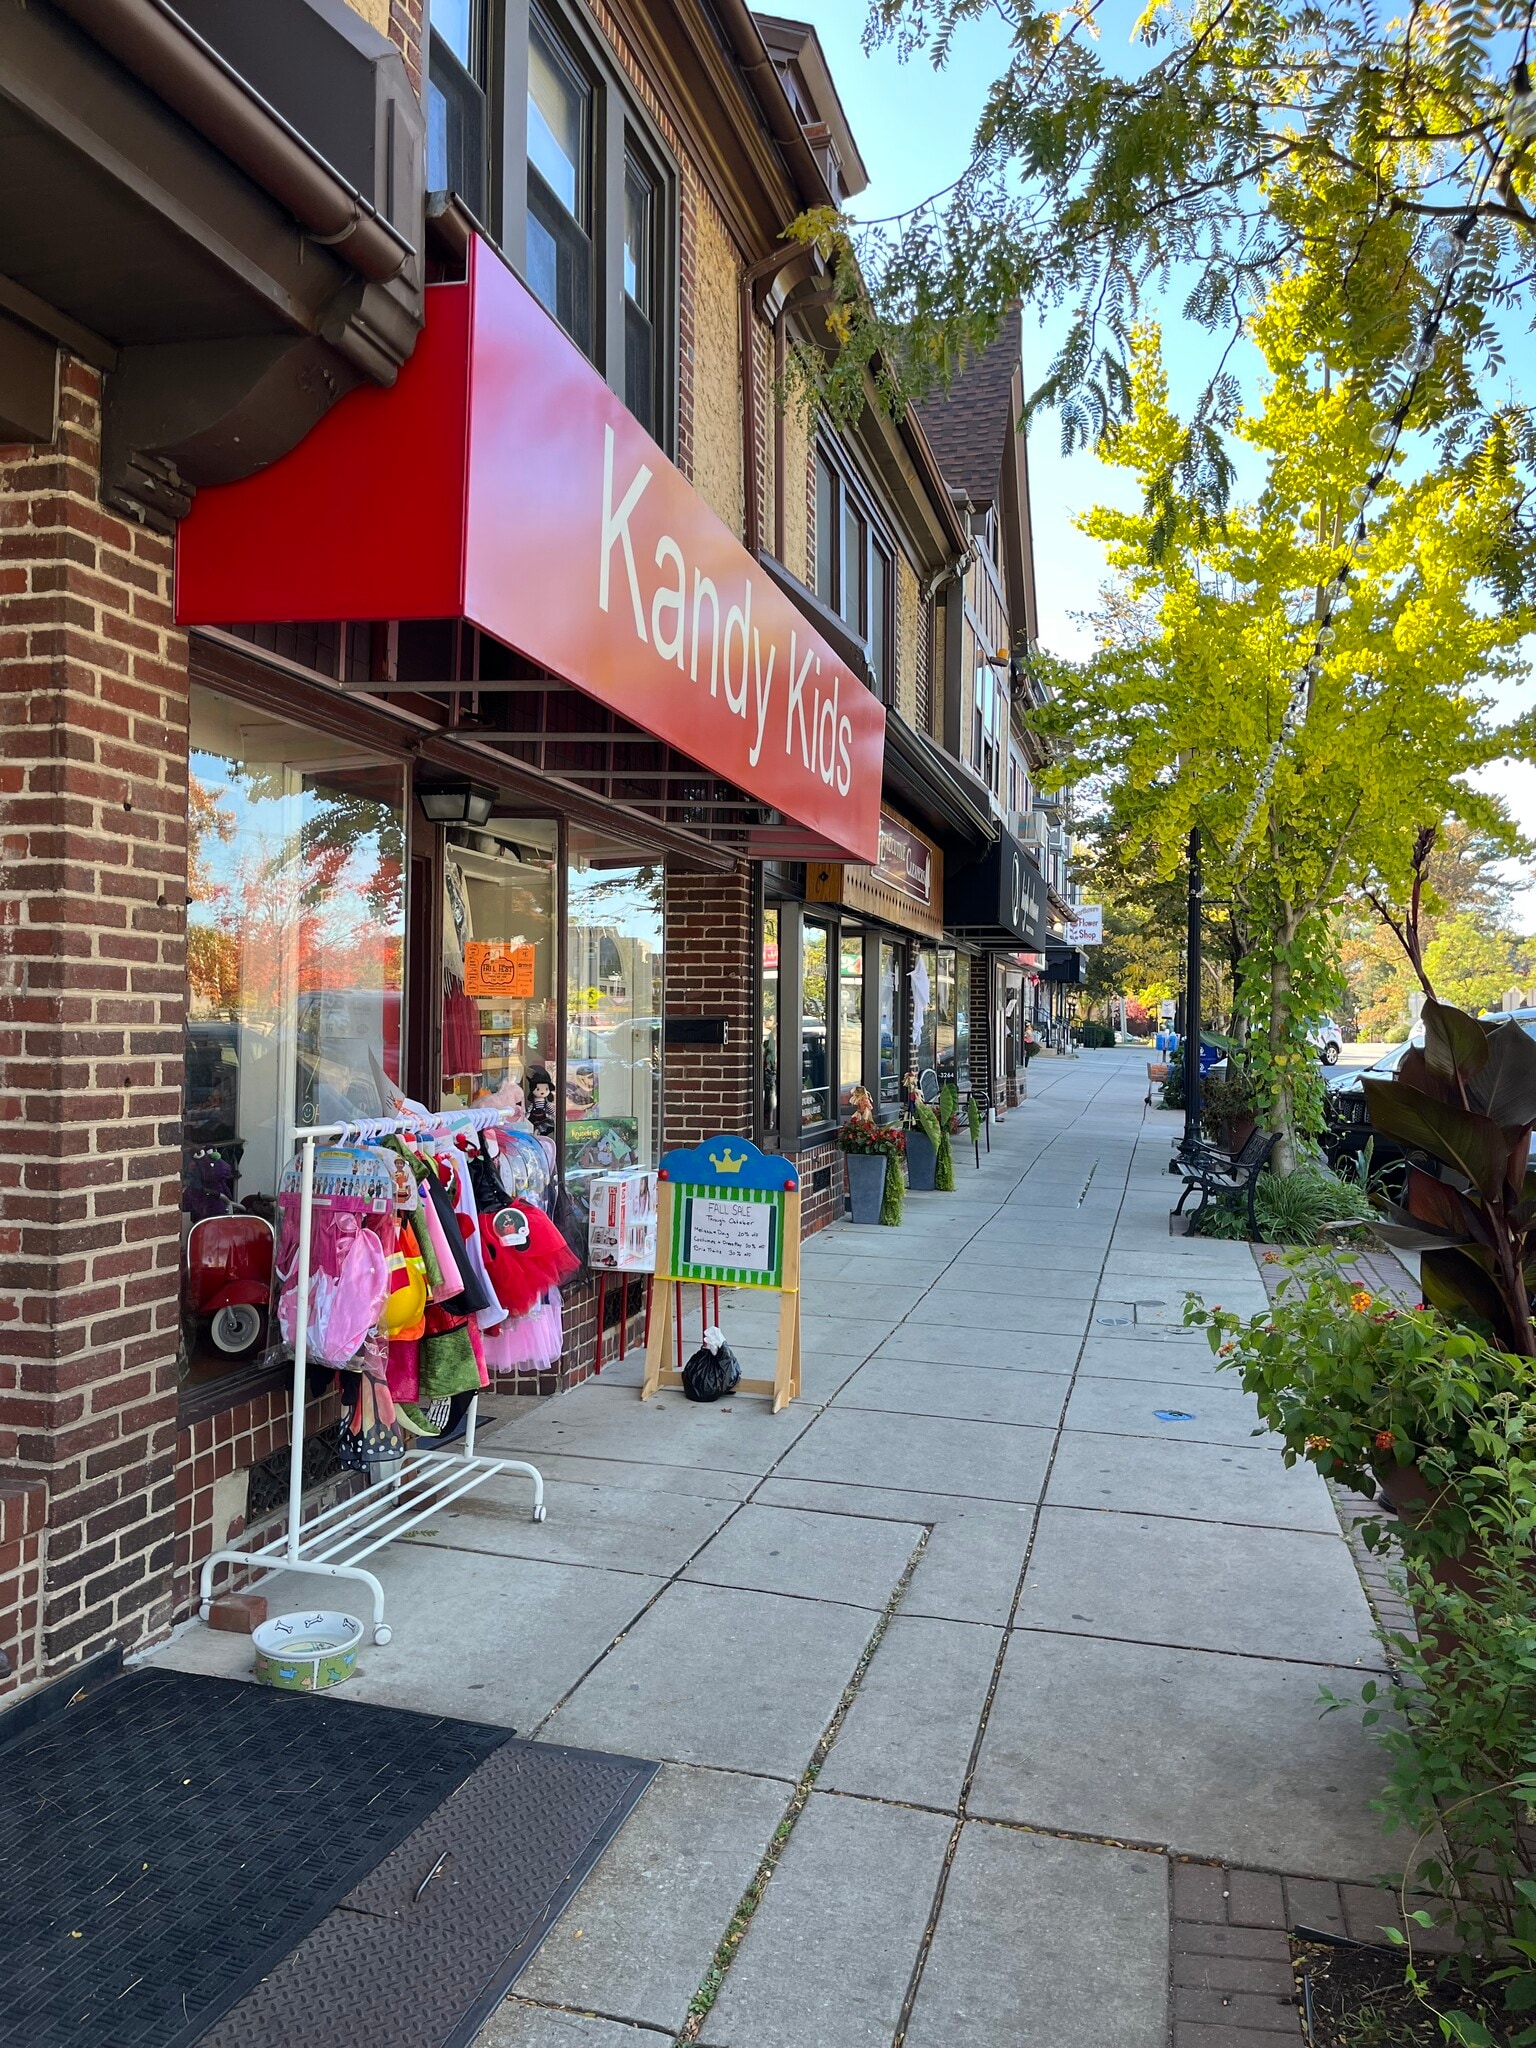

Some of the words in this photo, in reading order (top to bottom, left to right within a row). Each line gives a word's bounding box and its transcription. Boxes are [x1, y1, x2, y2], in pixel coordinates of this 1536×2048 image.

[598, 422, 776, 768] Kandy
[785, 629, 854, 797] Kids
[1079, 918, 1099, 927] Flower
[1079, 929, 1097, 941] Shop
[482, 963, 497, 973] FALL
[498, 963, 514, 973] FEST
[708, 1202, 729, 1215] FALL
[732, 1203, 752, 1217] SALE
[728, 1217, 755, 1226] October
